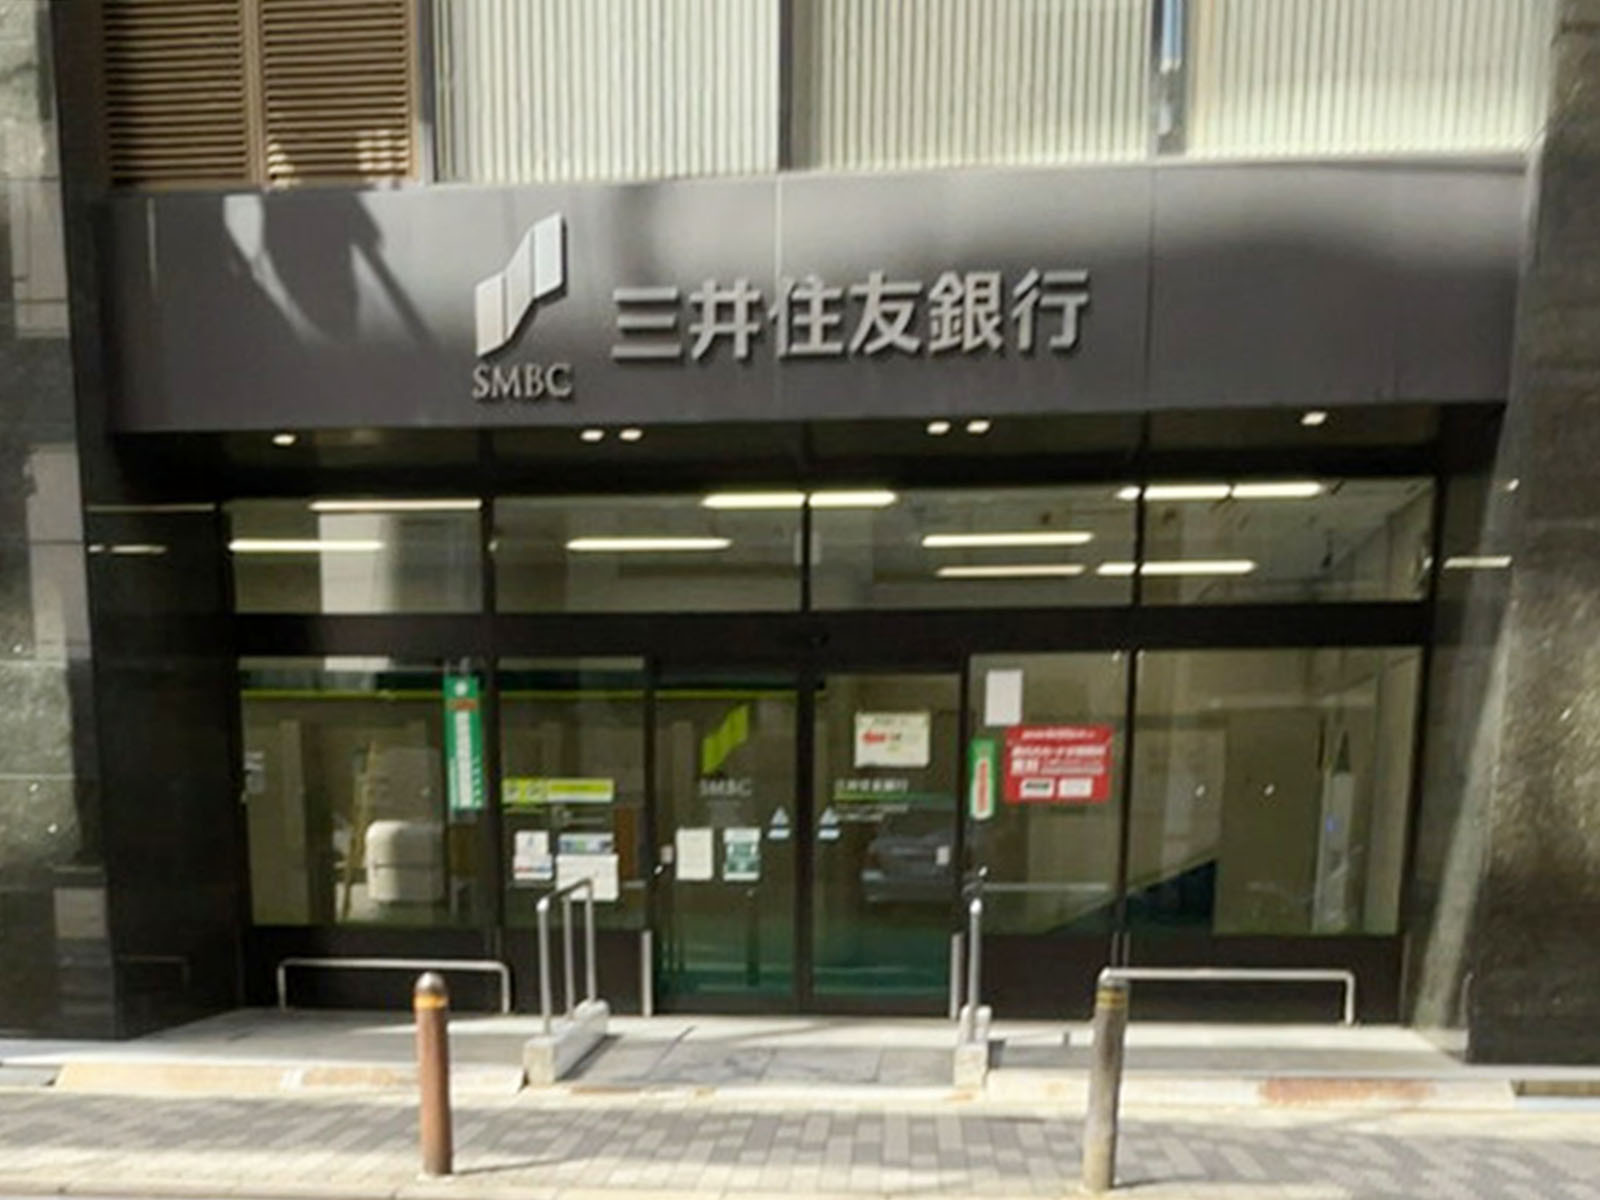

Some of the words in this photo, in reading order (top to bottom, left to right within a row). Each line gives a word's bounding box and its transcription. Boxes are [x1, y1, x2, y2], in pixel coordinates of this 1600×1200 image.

[612, 269, 1090, 360] 三井住友銀行
[472, 363, 573, 400] SMBC
